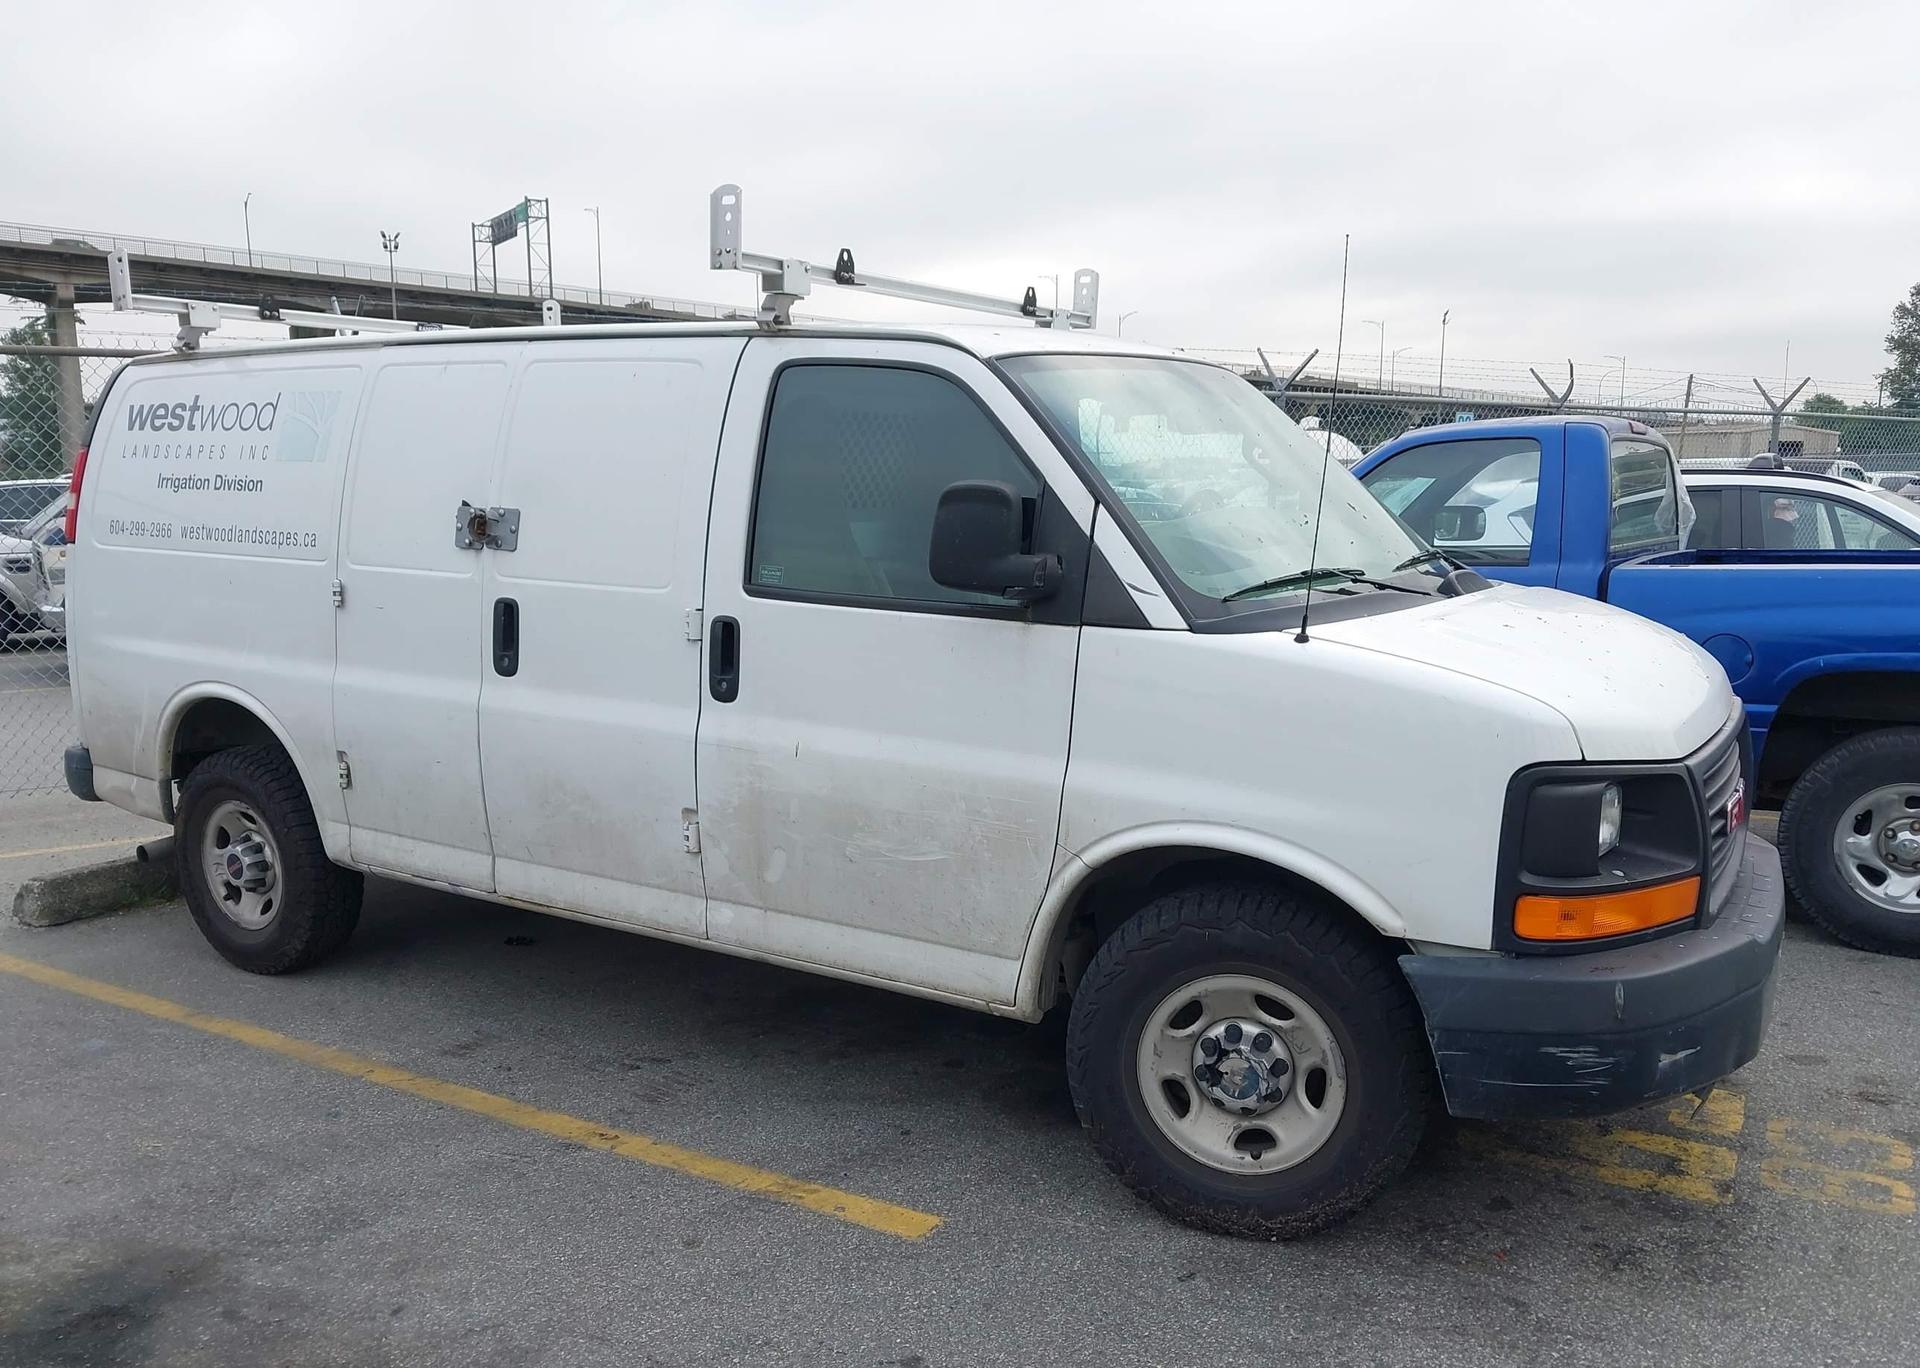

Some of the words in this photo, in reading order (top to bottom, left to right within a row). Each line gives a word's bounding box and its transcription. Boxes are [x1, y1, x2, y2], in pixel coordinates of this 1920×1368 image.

[127, 392, 281, 432] westwood
[122, 444, 226, 460] LANDSCAPES
[239, 444, 269, 461] INC
[157, 473, 210, 493] Irrigation
[213, 474, 263, 492] Division
[109, 519, 172, 538] 604-299-2966
[180, 524, 317, 549] westwoodlandscapes.ca
